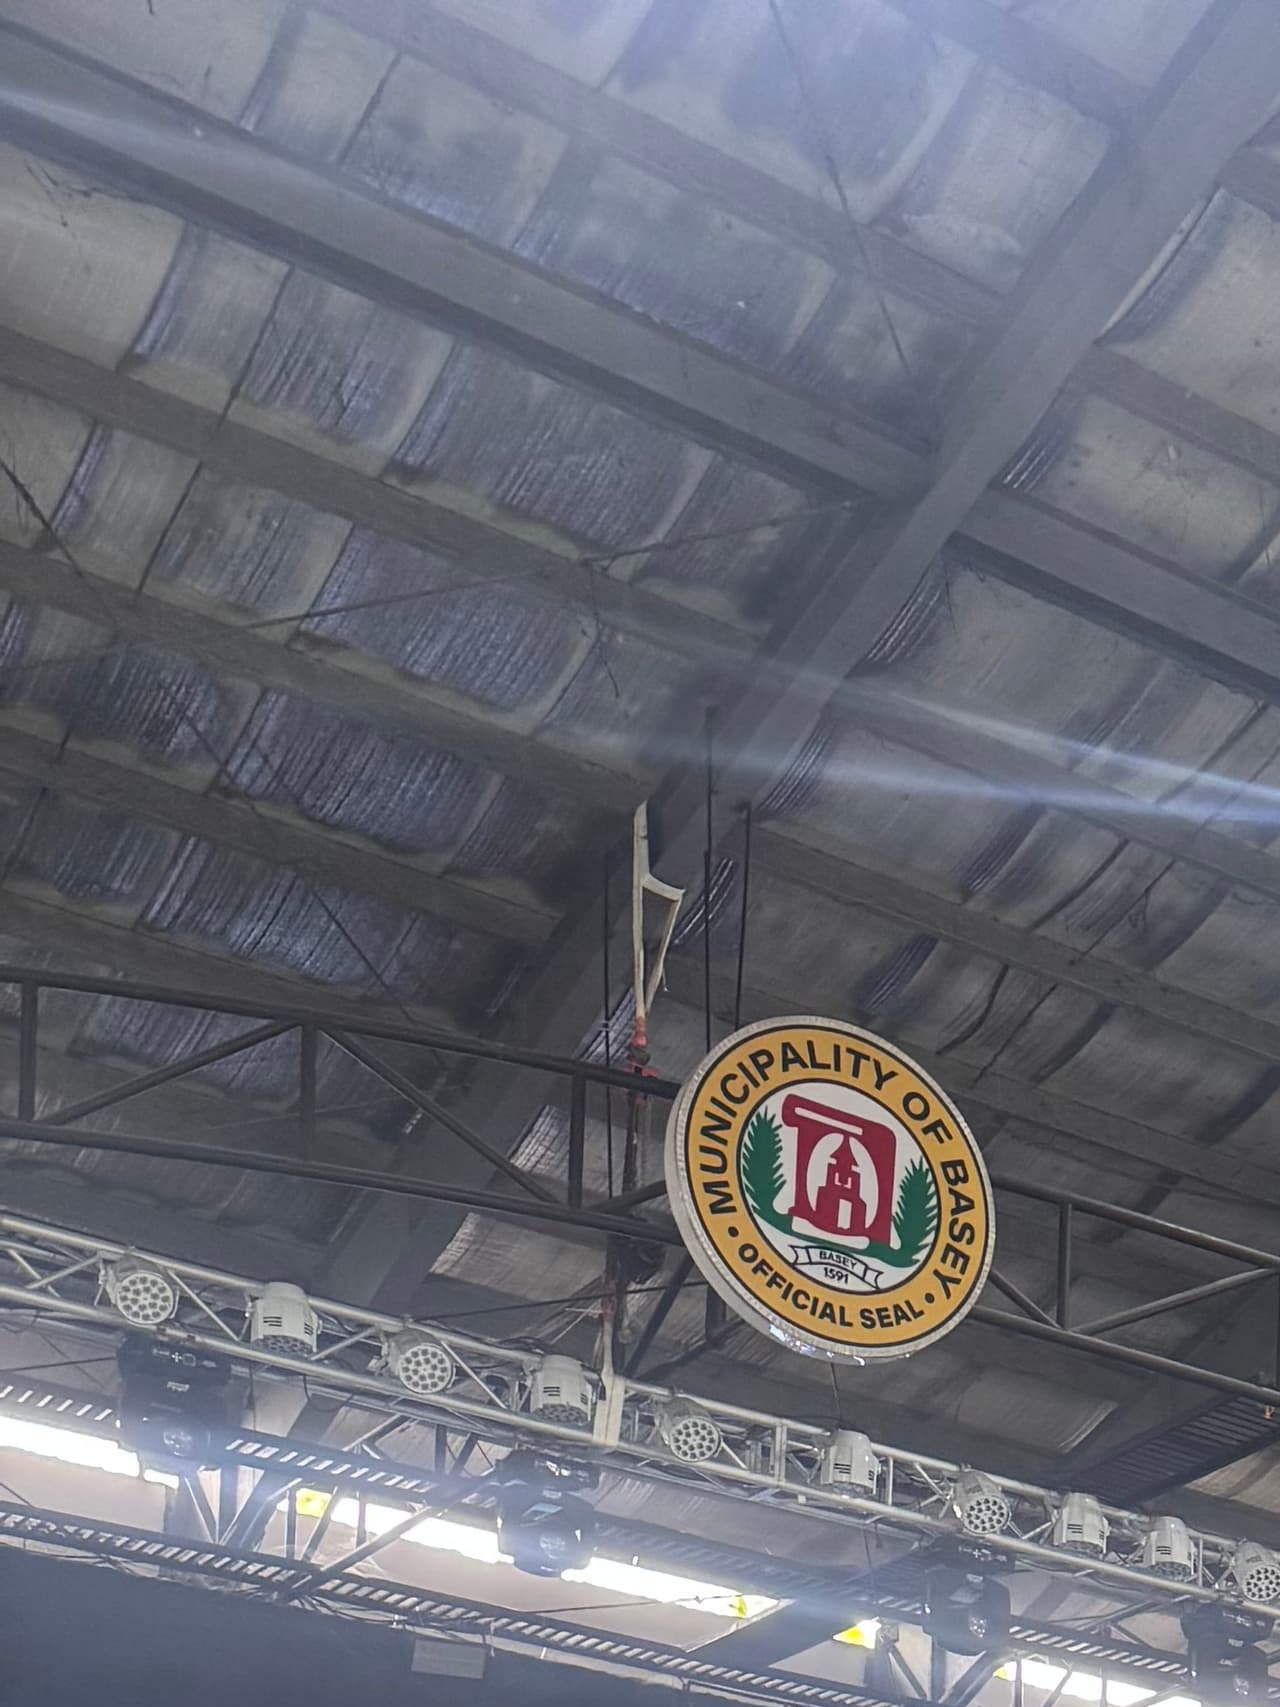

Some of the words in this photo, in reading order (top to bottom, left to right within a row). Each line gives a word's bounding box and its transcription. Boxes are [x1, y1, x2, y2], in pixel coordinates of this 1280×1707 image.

[699, 1040, 899, 1215] MUNICIPALITY
[902, 1091, 953, 1145] OF
[933, 1158, 976, 1301] BASEY
[738, 1243, 853, 1328] OFFICIAL
[860, 1299, 925, 1329] SEAL
[819, 1250, 857, 1270] BASEY
[823, 1266, 849, 1284] 1591
